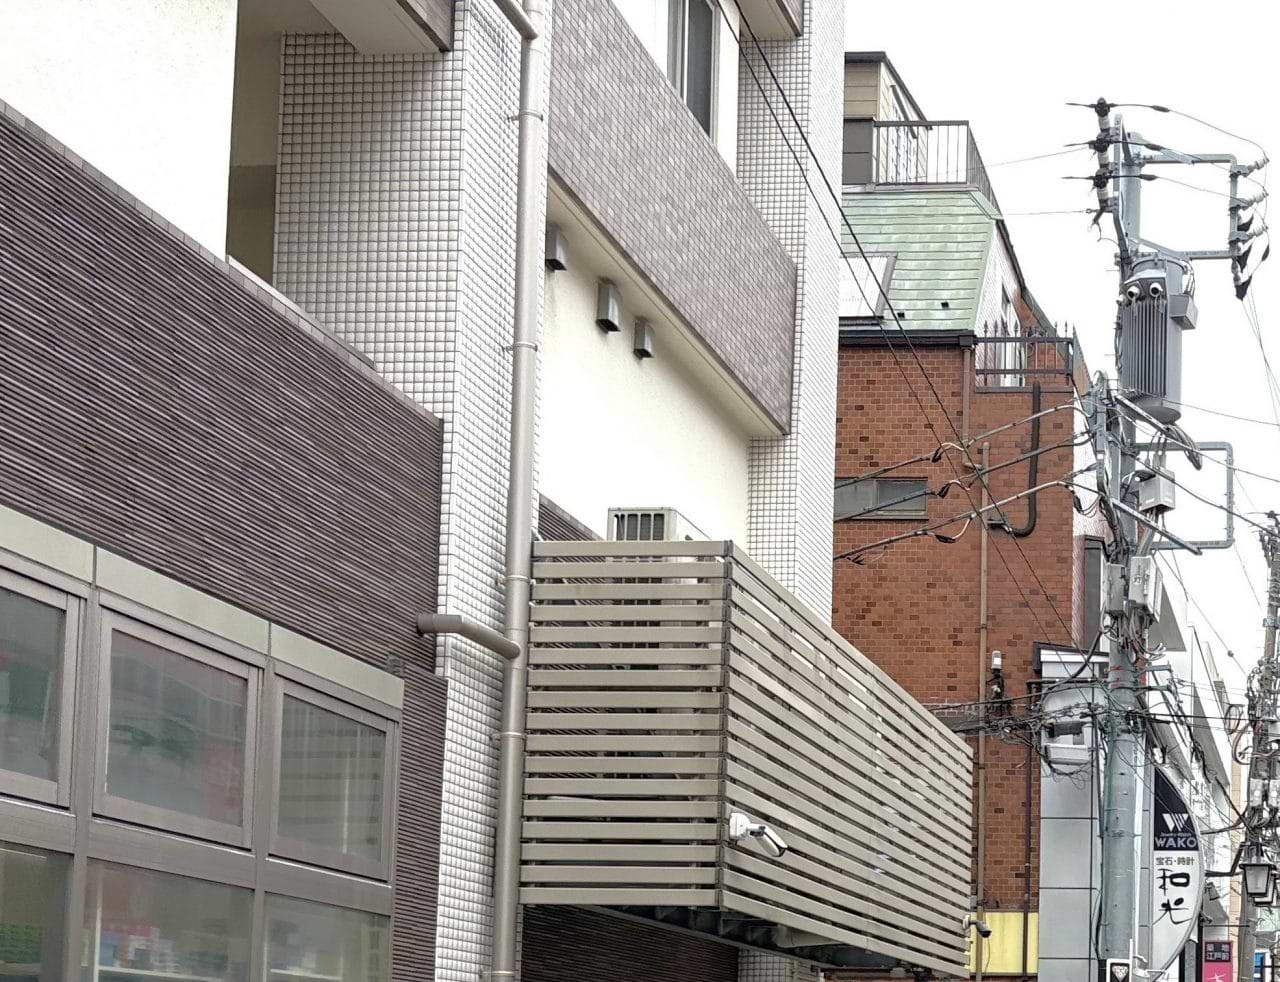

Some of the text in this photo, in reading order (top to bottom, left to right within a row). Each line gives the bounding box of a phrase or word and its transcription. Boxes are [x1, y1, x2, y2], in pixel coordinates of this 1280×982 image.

[1154, 837, 1197, 848] WAKO
[1156, 856, 1196, 866] 宝石・時計
